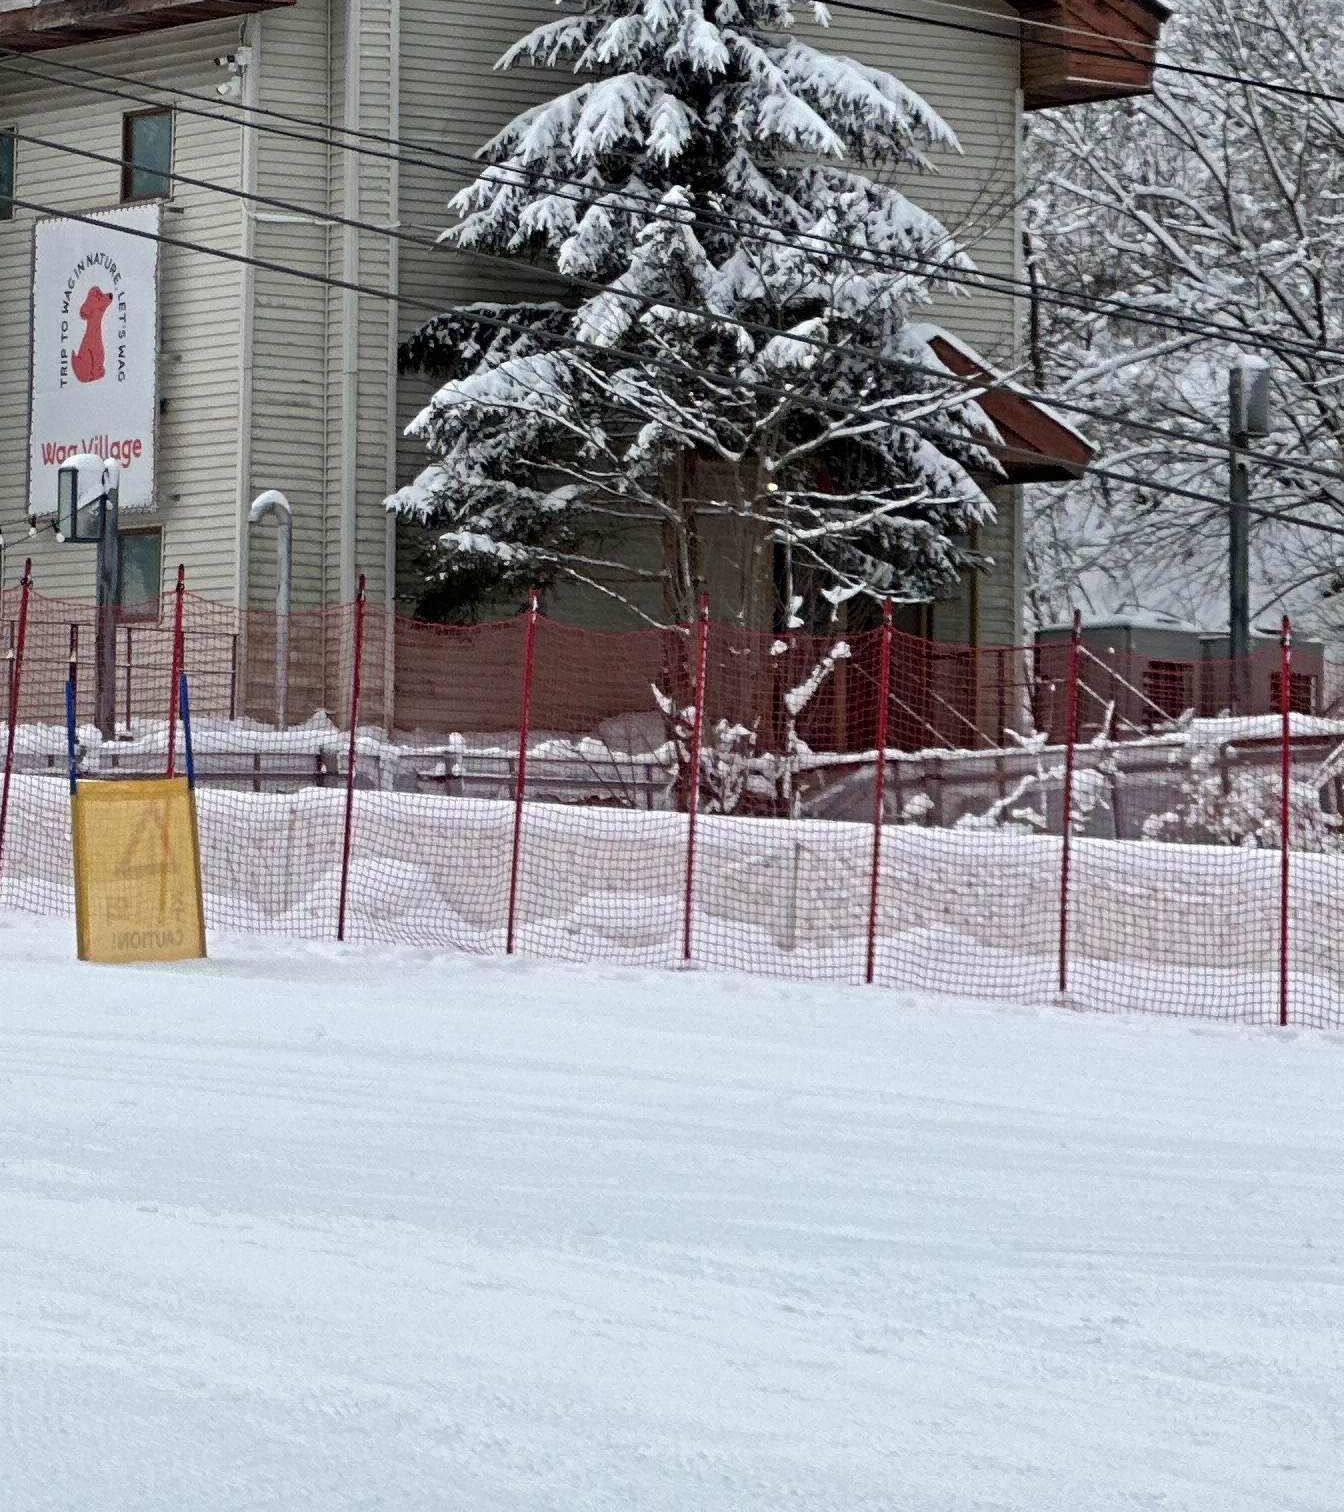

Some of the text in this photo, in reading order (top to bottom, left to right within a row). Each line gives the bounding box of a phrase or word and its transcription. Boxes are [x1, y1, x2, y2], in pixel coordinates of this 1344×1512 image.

[74, 260, 85, 280] IN
[61, 277, 76, 314] WAG
[60, 320, 68, 343] TO
[60, 348, 68, 388] TRIP
[117, 345, 126, 382] WAG
[81, 434, 142, 468] Village
